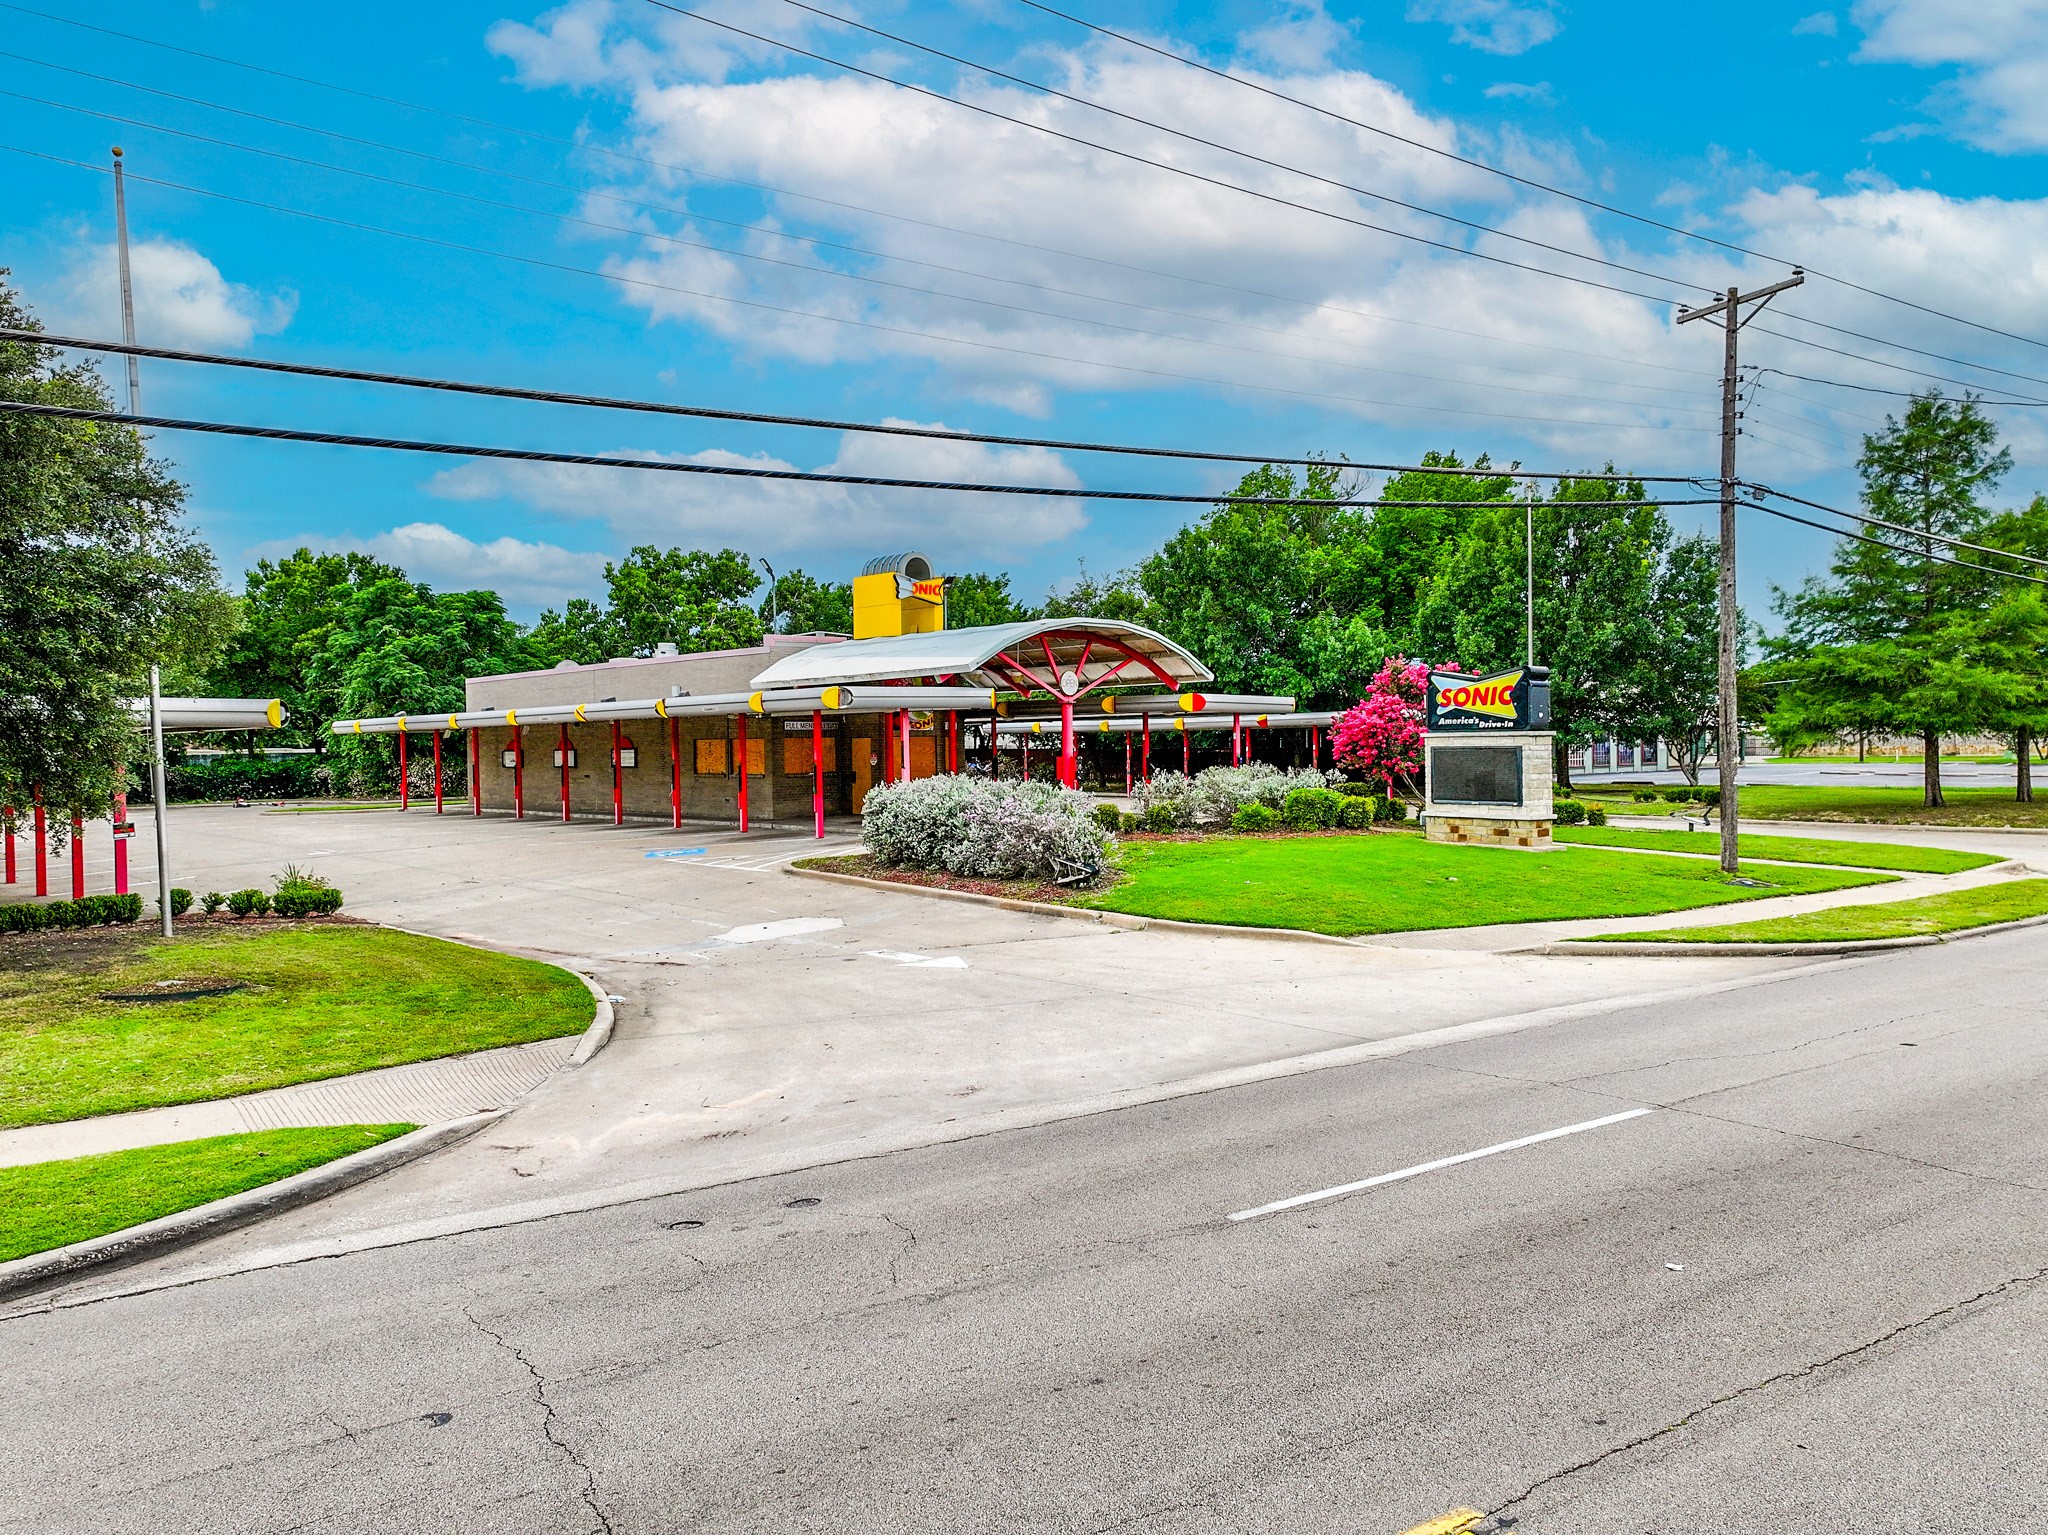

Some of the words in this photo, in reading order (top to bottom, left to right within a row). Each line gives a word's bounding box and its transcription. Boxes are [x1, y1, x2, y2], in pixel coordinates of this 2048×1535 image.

[1439, 685, 1514, 708] SONIC
[785, 722, 800, 730] FULL
[801, 722, 814, 730] MEN
[1438, 716, 1479, 726] America's
